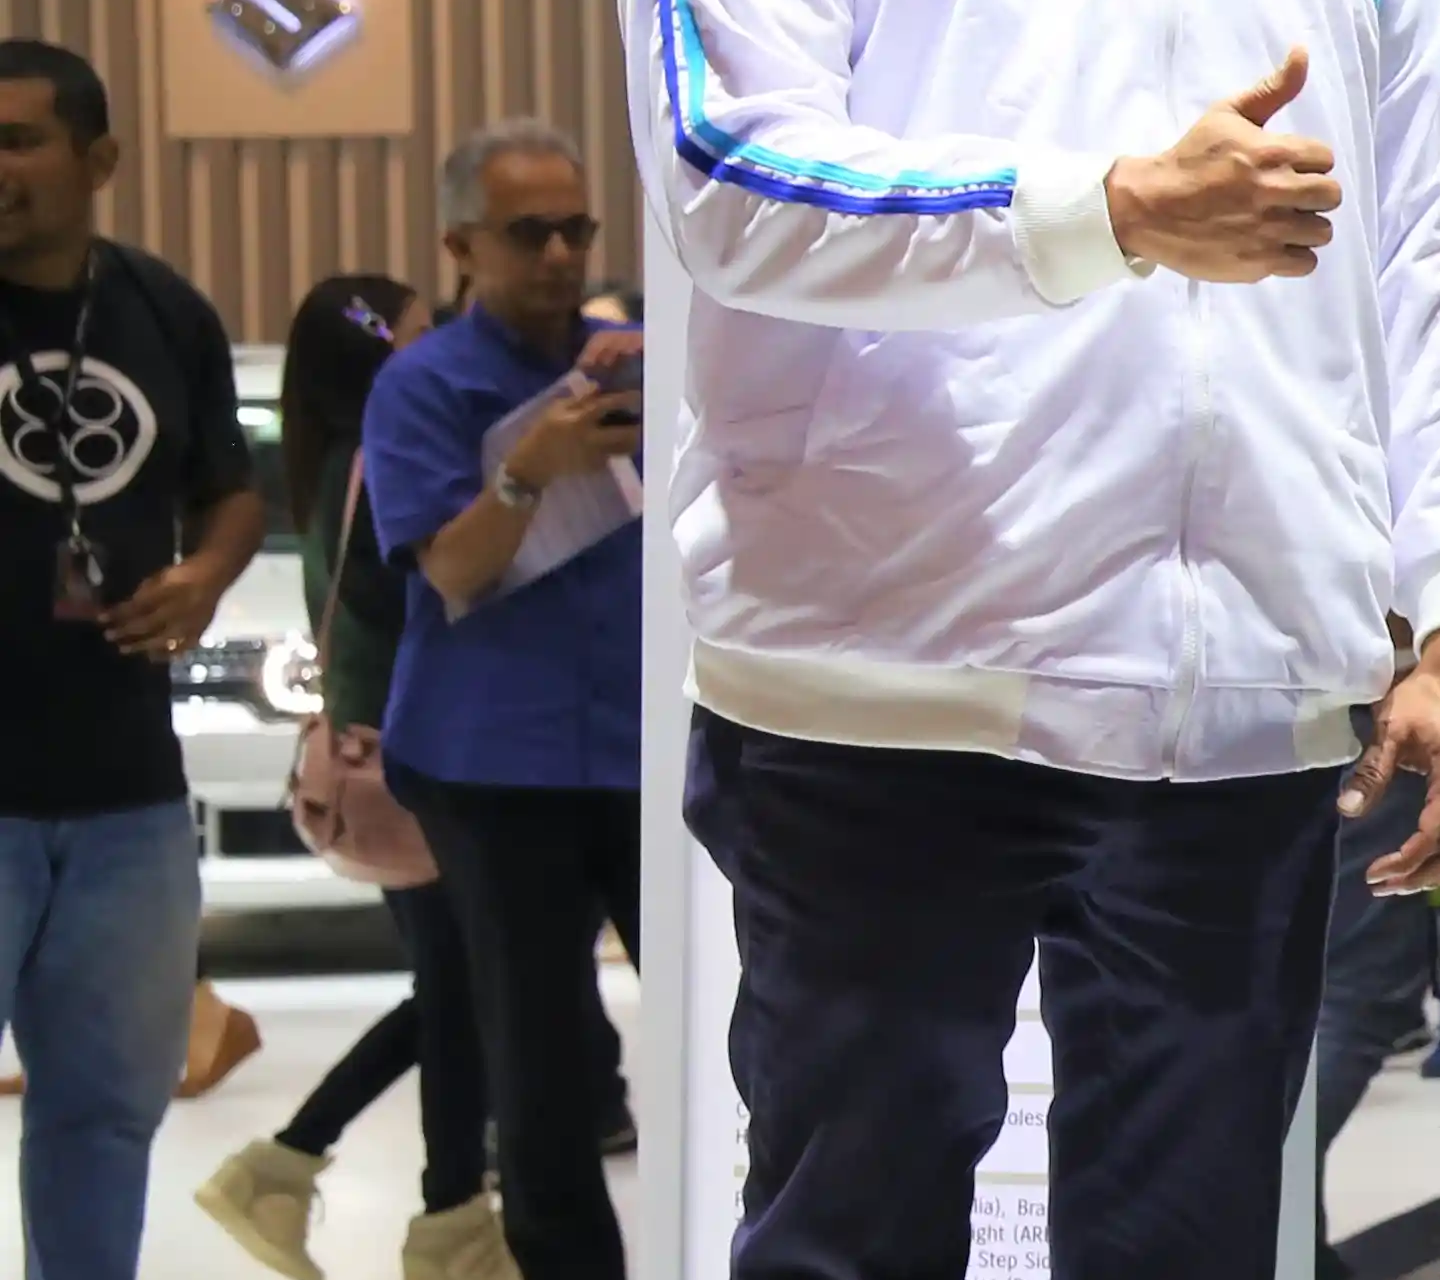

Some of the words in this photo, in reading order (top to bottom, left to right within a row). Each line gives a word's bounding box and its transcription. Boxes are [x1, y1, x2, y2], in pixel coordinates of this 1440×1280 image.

[1007, 1108, 1045, 1128] oles
[1017, 1198, 1046, 1217] Bra
[971, 1224, 1004, 1246] ight
[978, 1251, 1018, 1272] Step
